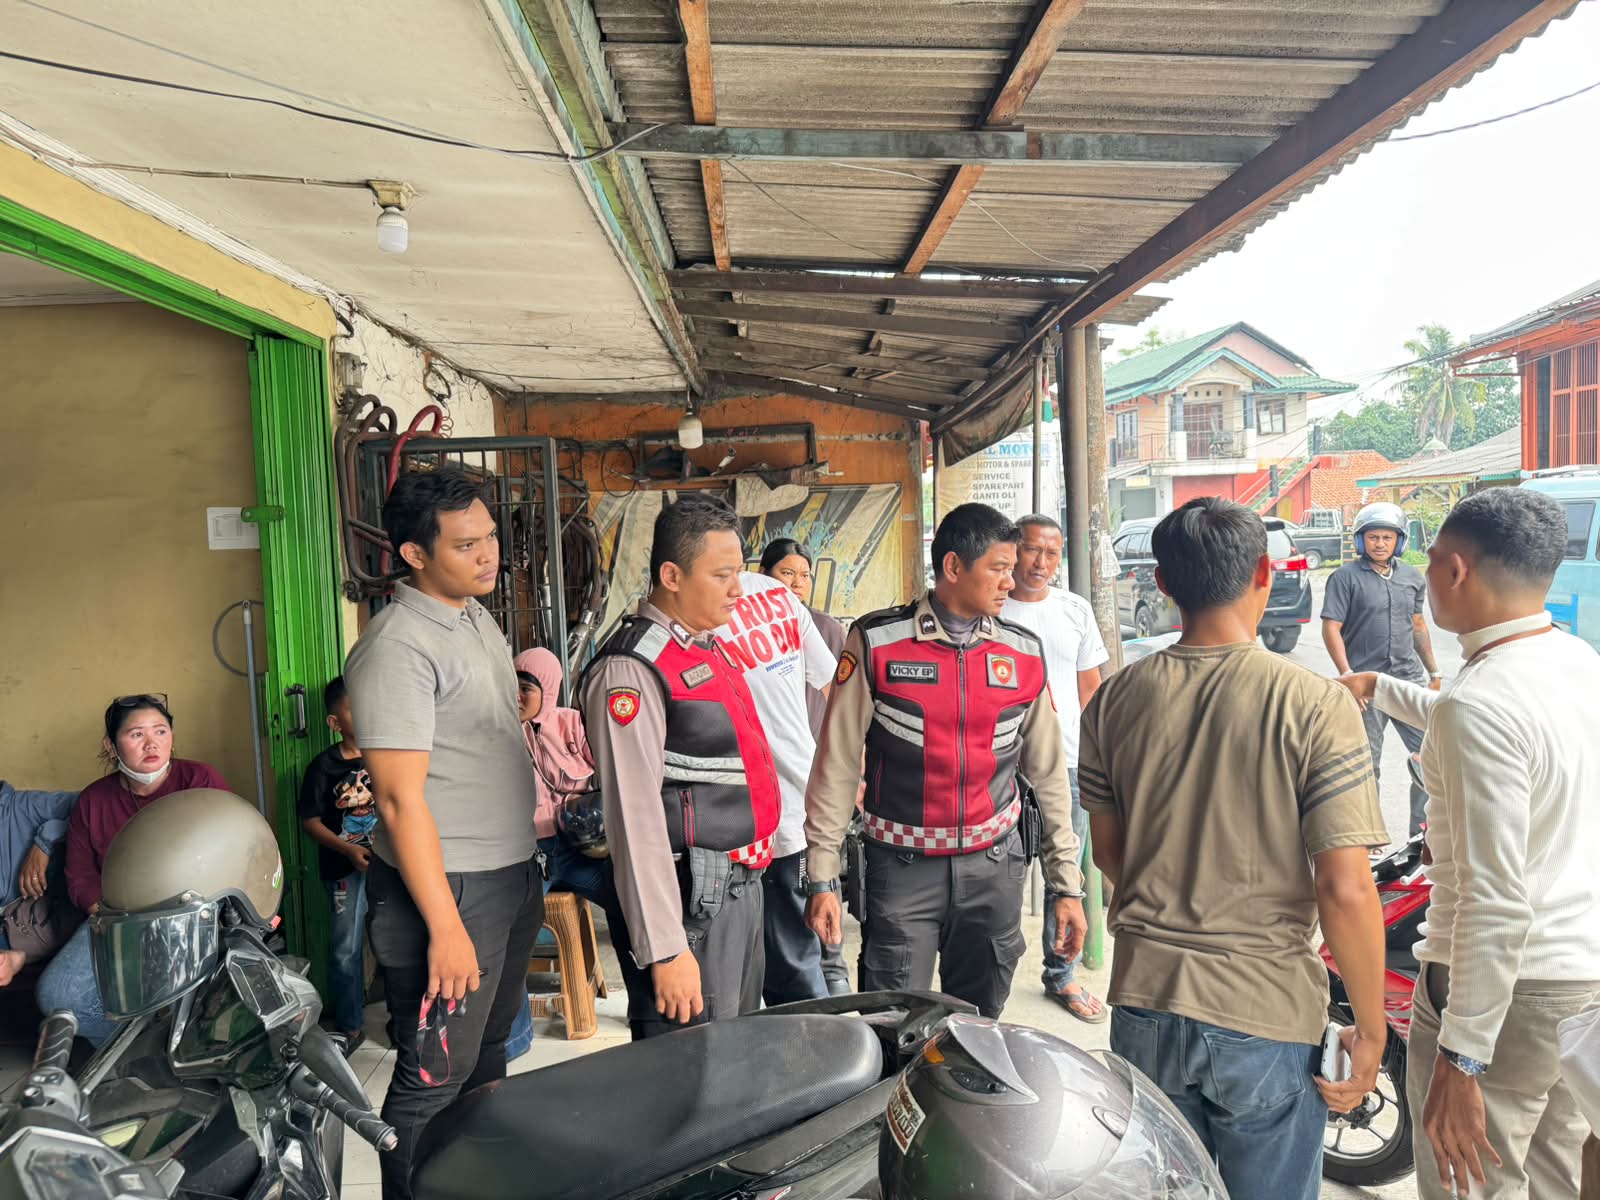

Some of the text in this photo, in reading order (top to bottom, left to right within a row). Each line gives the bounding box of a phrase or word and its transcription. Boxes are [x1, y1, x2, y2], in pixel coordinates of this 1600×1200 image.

[999, 444, 1050, 454] MOTR
[973, 482, 1024, 490] SPAREPART
[999, 502, 1010, 510] UP
[921, 667, 933, 676] EP
